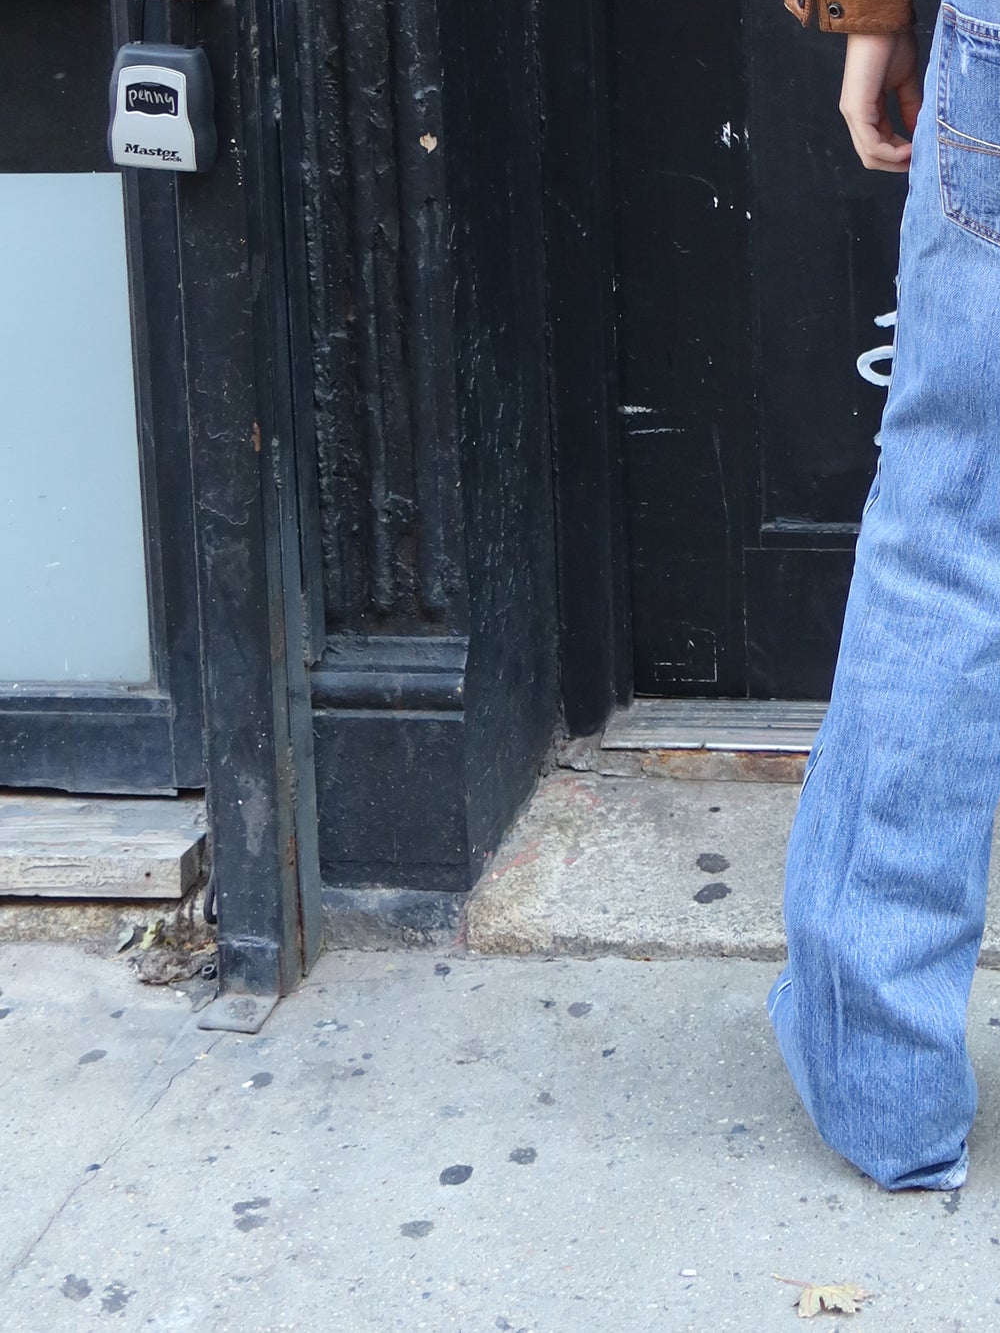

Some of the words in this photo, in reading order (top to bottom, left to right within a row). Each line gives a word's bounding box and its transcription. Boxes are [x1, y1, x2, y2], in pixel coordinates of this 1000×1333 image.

[127, 88, 176, 114] penny
[124, 143, 179, 158] Master
[162, 154, 182, 163] Lock
